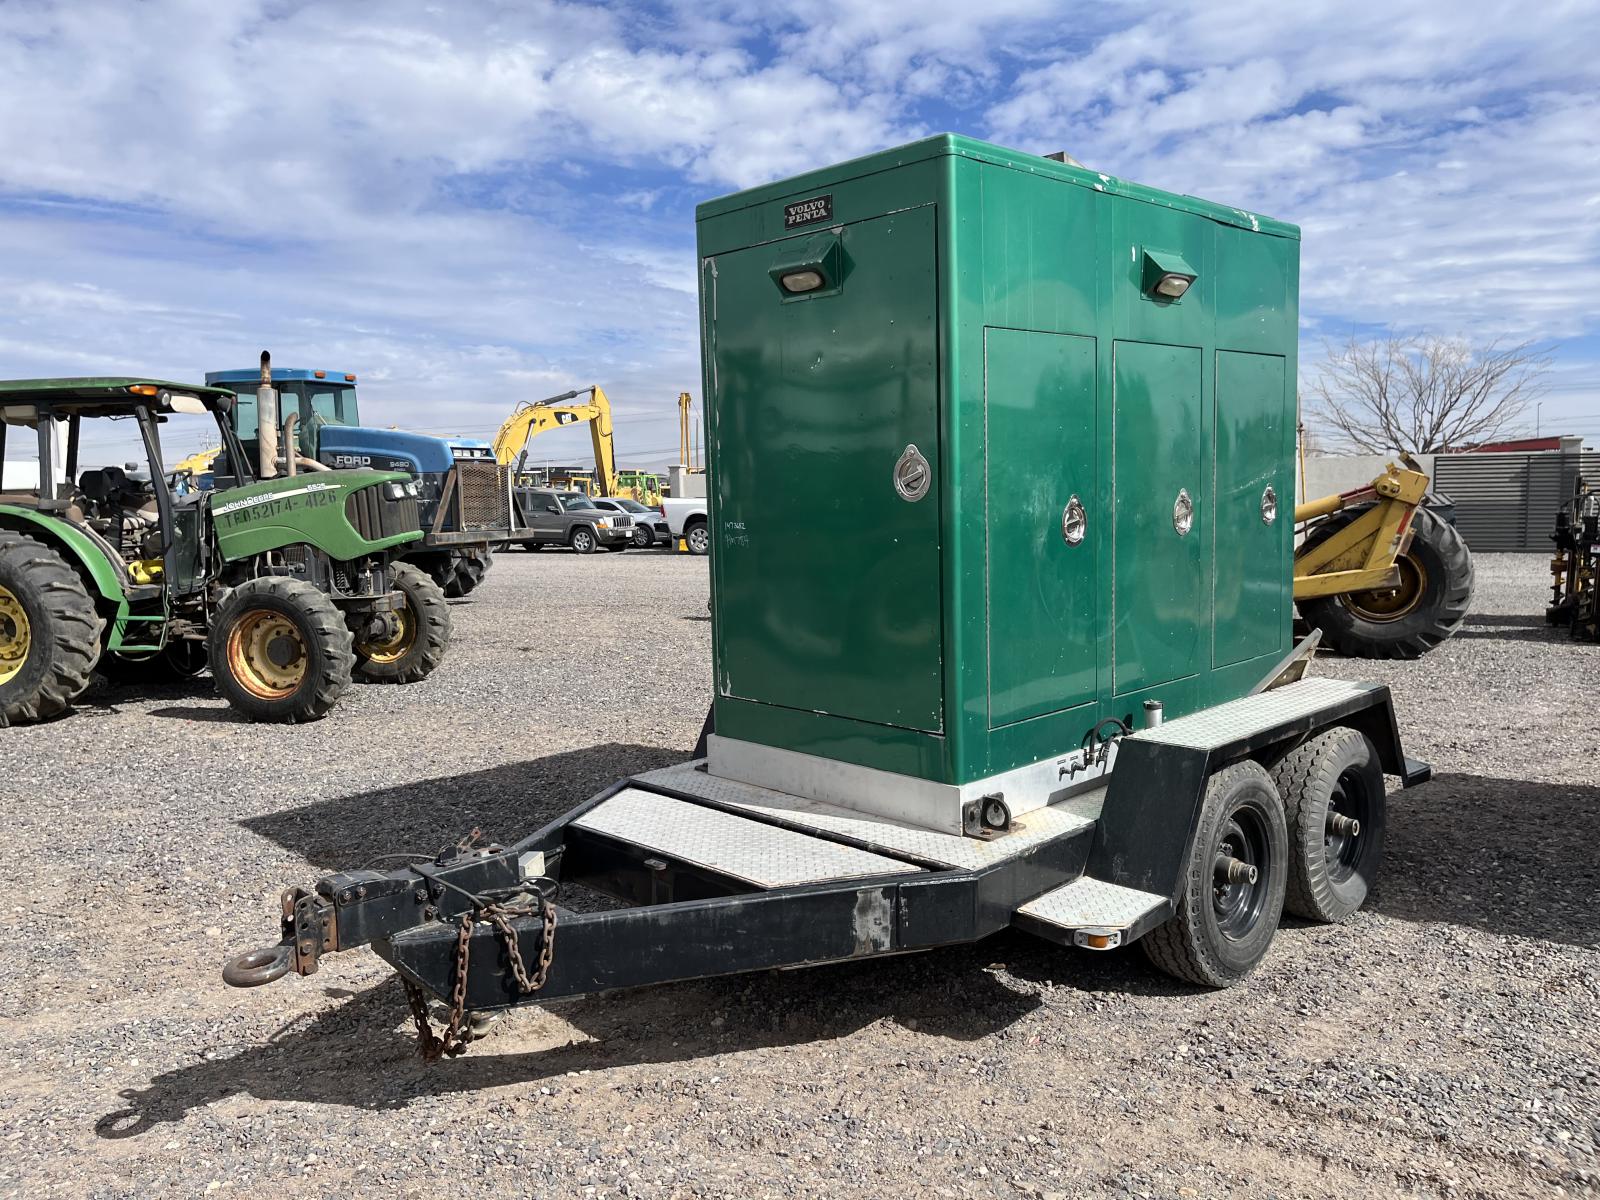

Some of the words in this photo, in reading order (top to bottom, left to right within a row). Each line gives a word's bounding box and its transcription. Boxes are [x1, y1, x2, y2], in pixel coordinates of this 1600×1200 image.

[788, 200, 825, 215] VOLVO
[788, 208, 828, 224] PENTA
[561, 413, 572, 424] CAT
[336, 456, 371, 465] FORD
